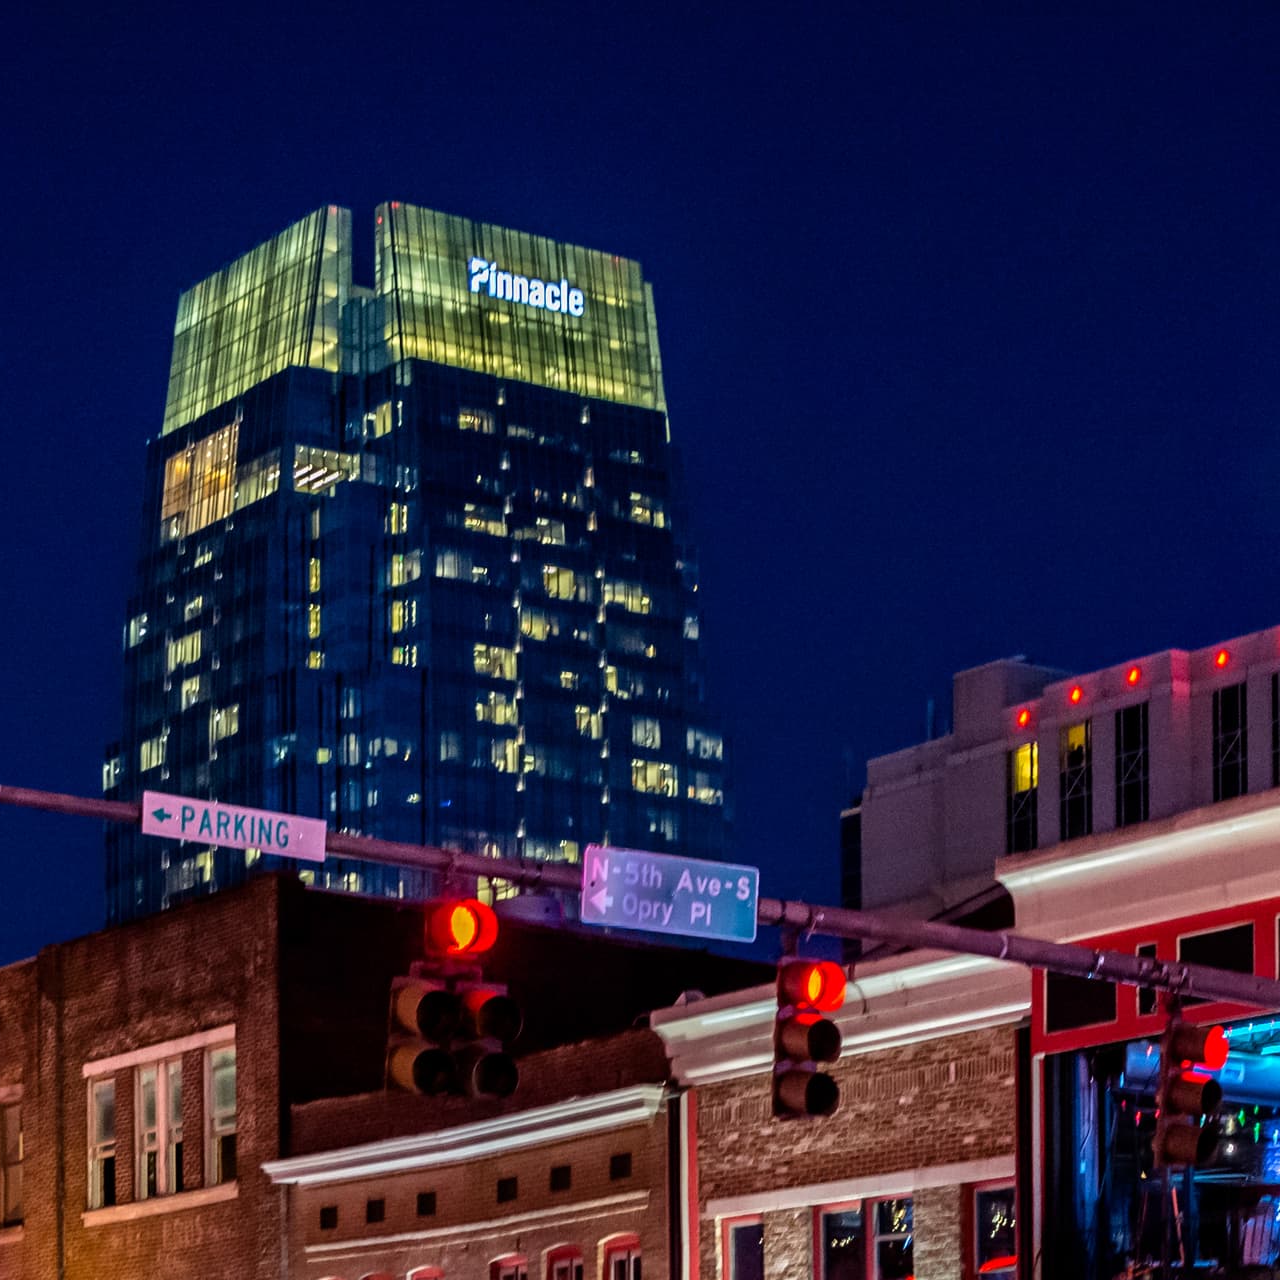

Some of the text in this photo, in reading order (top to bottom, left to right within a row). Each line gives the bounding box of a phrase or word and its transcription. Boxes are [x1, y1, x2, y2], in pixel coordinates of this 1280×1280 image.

[471, 257, 584, 317] Pinnacle
[181, 805, 289, 848] PARKING
[622, 892, 712, 926] Opry Pl
